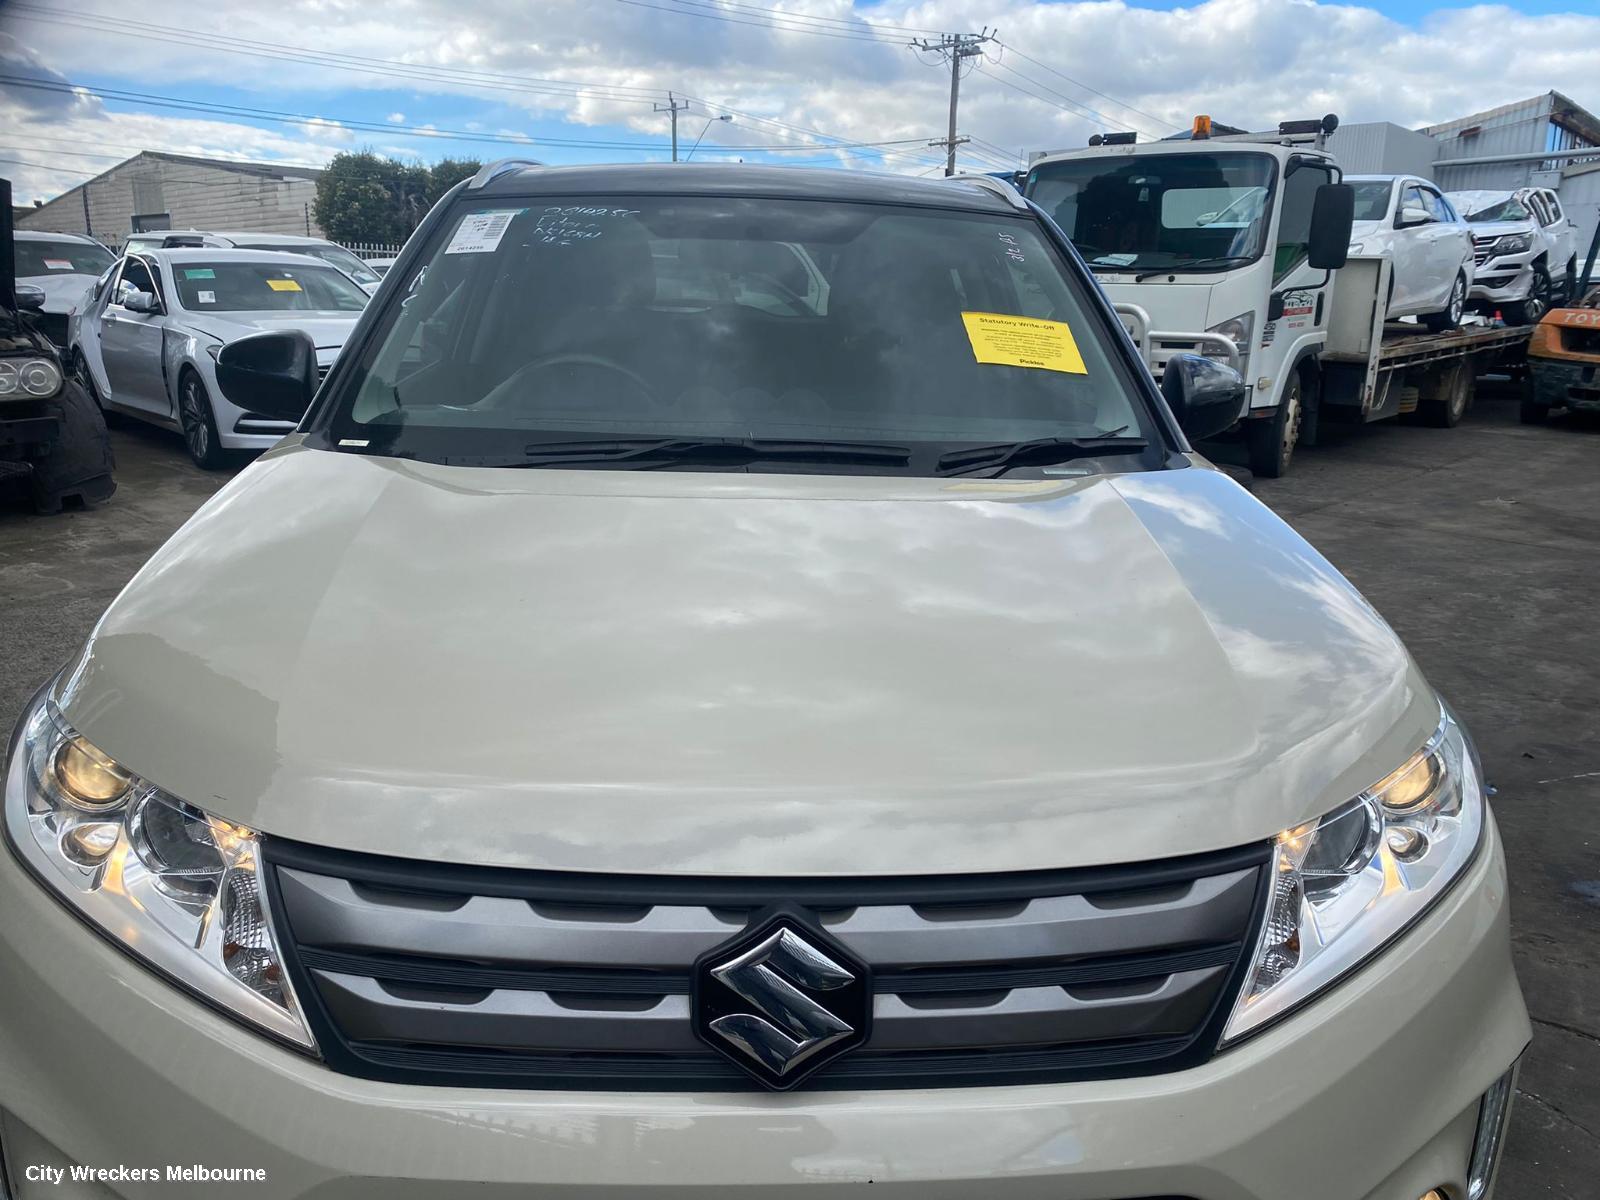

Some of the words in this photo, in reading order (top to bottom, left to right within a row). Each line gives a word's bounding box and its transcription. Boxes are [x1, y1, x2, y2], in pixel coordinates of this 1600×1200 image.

[979, 317, 1017, 327] Statutory
[1018, 321, 1056, 331] Write-Off
[1019, 358, 1046, 366] Pickles
